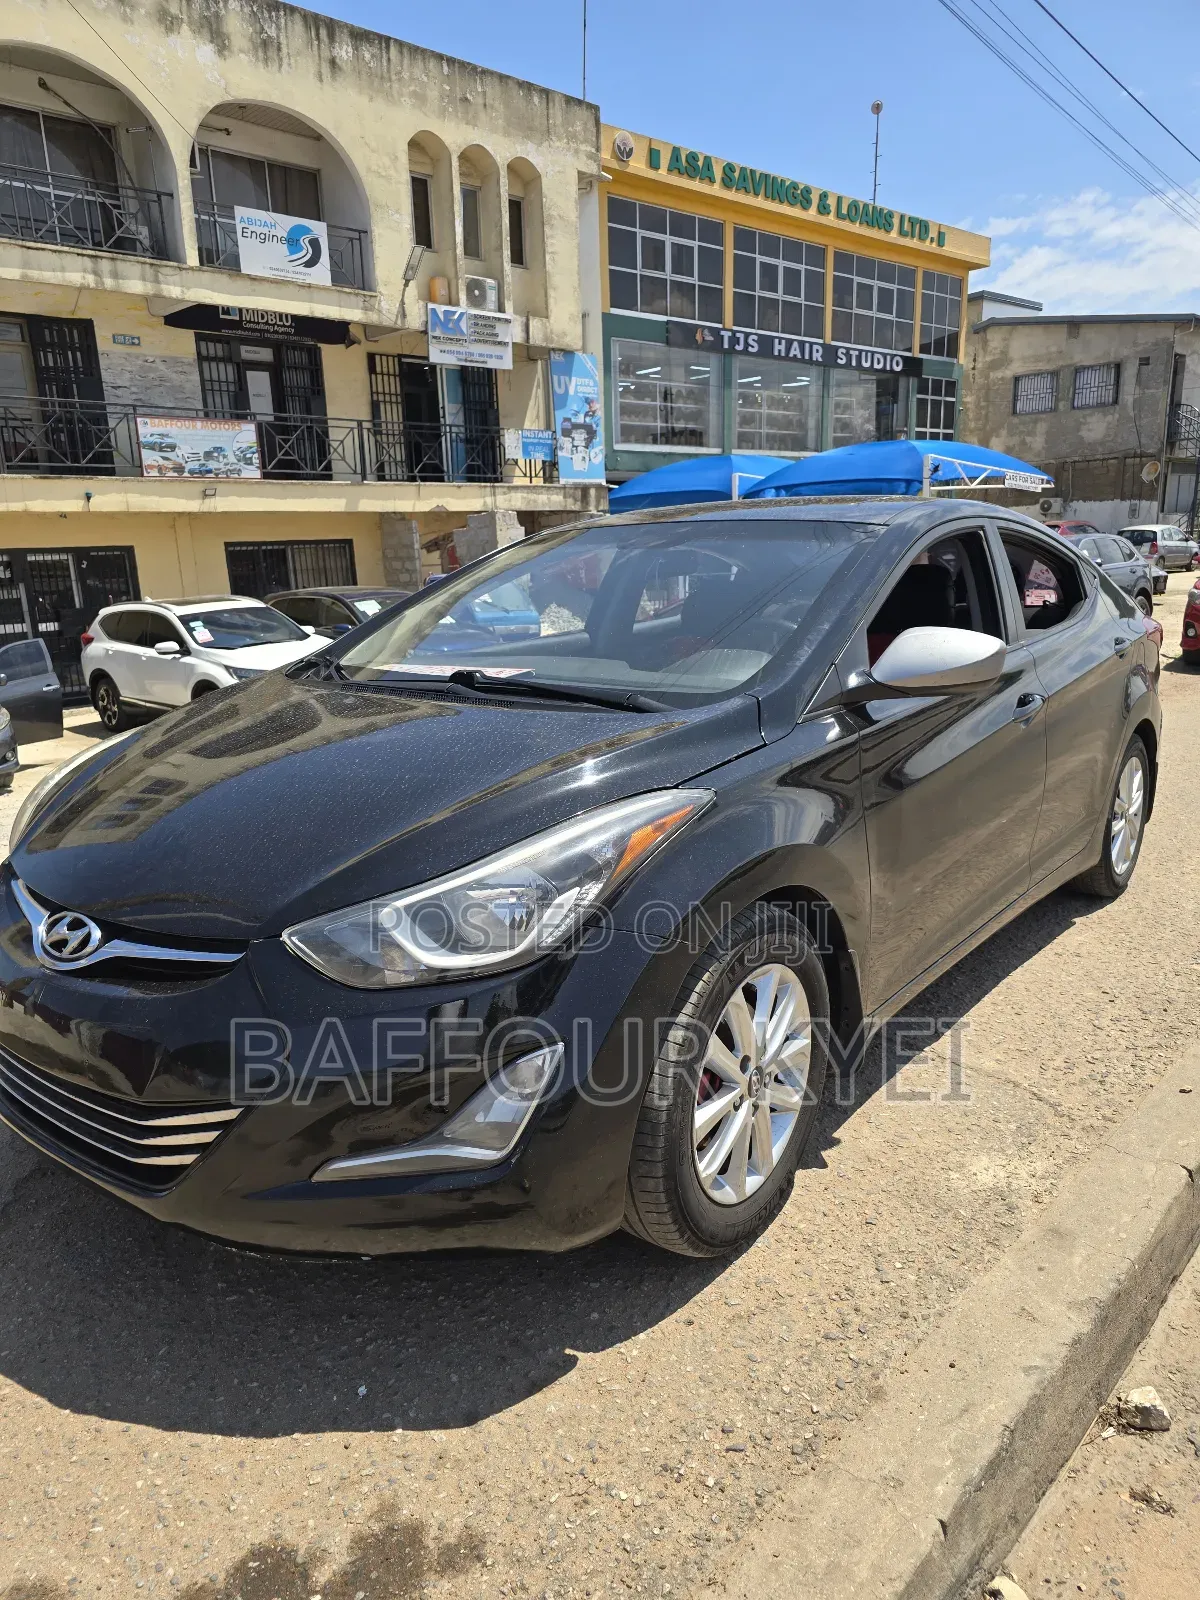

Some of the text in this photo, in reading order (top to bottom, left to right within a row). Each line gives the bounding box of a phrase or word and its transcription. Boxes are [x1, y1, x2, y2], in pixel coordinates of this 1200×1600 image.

[667, 146, 935, 243] ASA SAVINGS & LOANS LTD.
[239, 216, 277, 230] ABIJAH
[241, 227, 300, 247] Engineer
[242, 308, 292, 326] MIDBLU
[429, 308, 467, 337] NEK
[242, 321, 294, 335] Consulting Agency
[473, 330, 499, 338] PACKAGING
[719, 330, 903, 372] TJS HAIR STUDIO
[553, 374, 576, 396] UV
[150, 418, 198, 429] BAFFOUR
[200, 420, 242, 431] MOTORS
[522, 430, 553, 439] INSTANT
[530, 451, 545, 459] TIME
[1018, 475, 1029, 484] FOR
